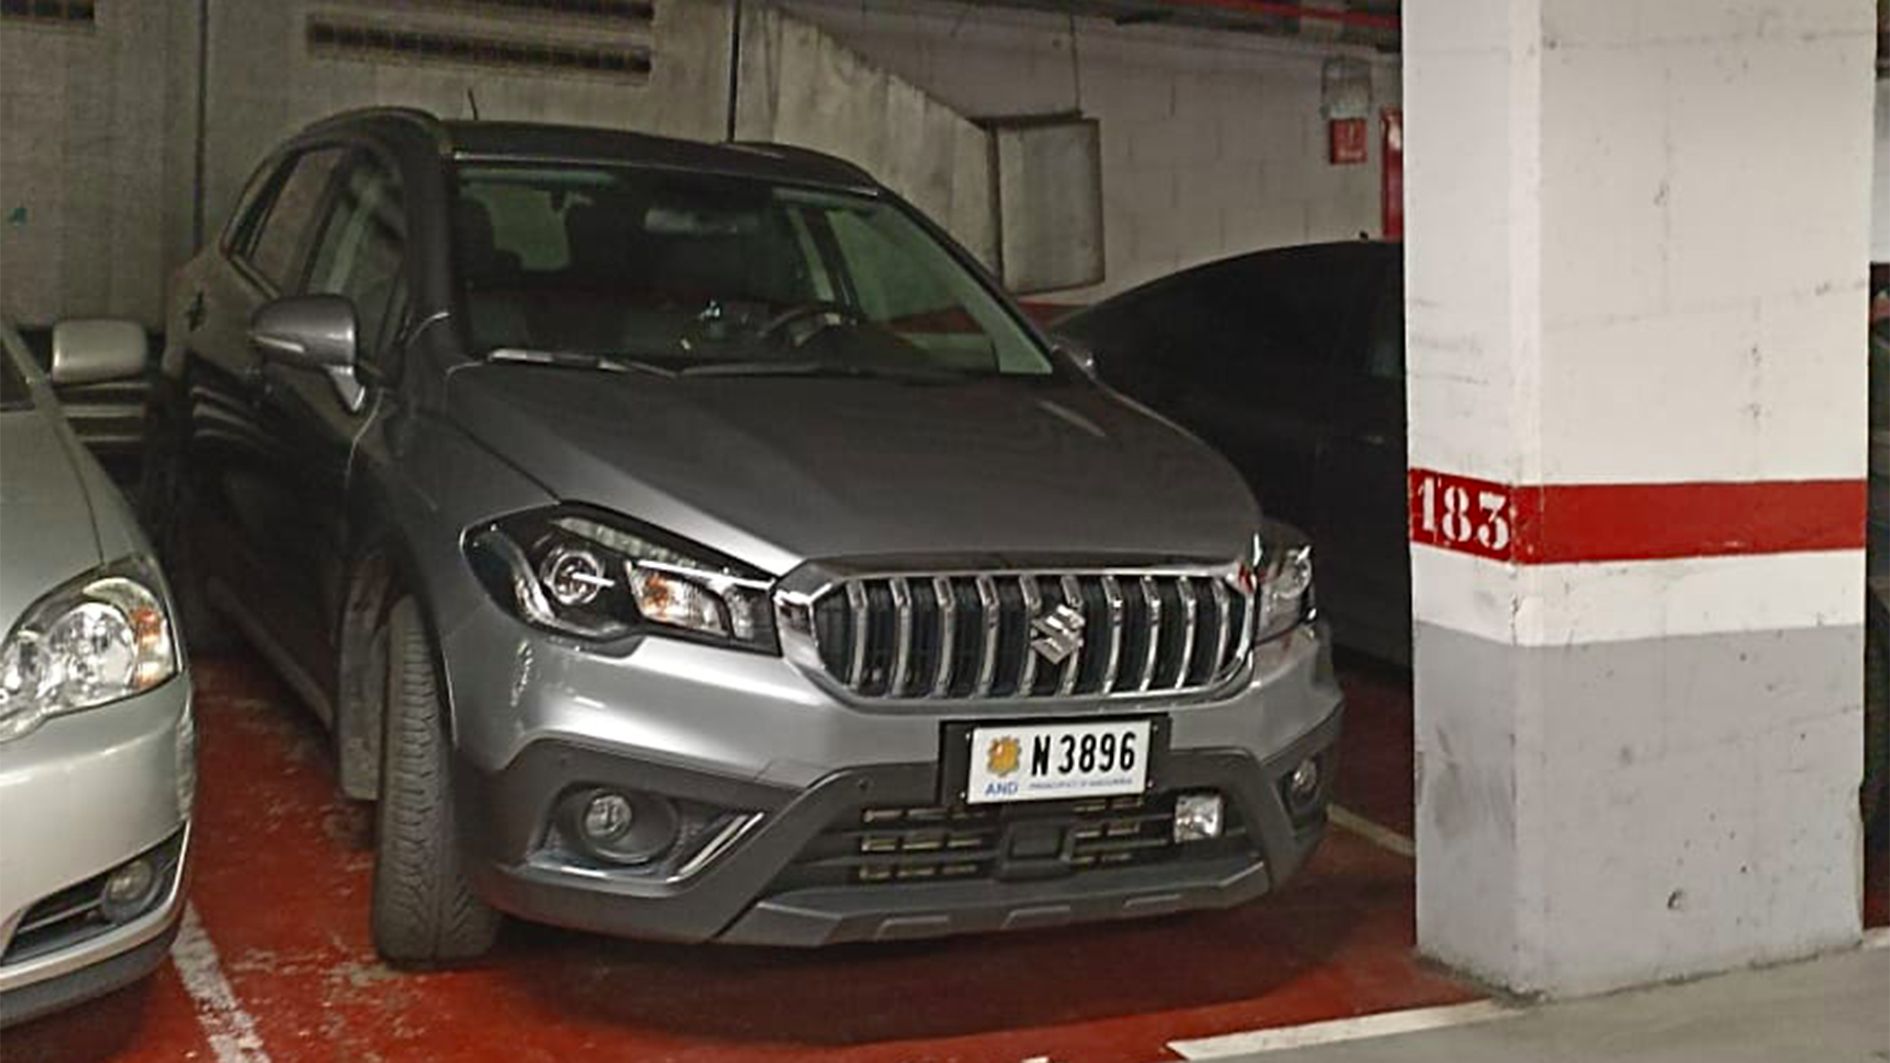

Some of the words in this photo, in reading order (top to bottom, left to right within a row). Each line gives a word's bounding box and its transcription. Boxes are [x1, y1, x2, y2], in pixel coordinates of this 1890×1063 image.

[1418, 477, 1509, 549] 183
[1031, 735, 1050, 776] N
[1058, 732, 1136, 774] 3896
[985, 782, 1018, 795] AND
